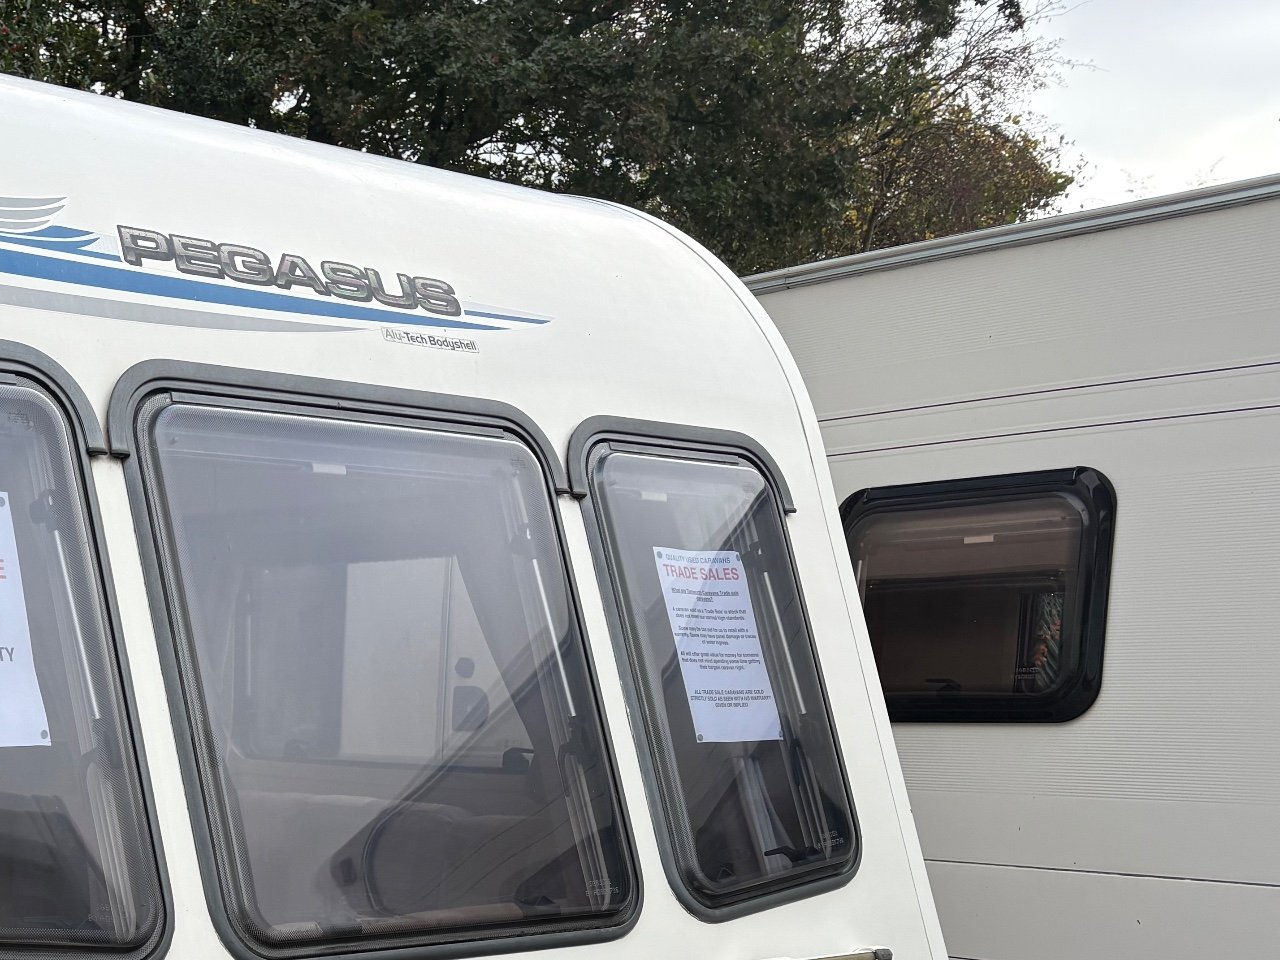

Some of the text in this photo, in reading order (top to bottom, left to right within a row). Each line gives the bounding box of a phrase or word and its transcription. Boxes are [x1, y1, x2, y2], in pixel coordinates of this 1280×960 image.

[117, 225, 462, 317] PEGASUS
[385, 328, 477, 351] Alu-Tech Bodyshell
[662, 564, 740, 580] TRADE SALES
